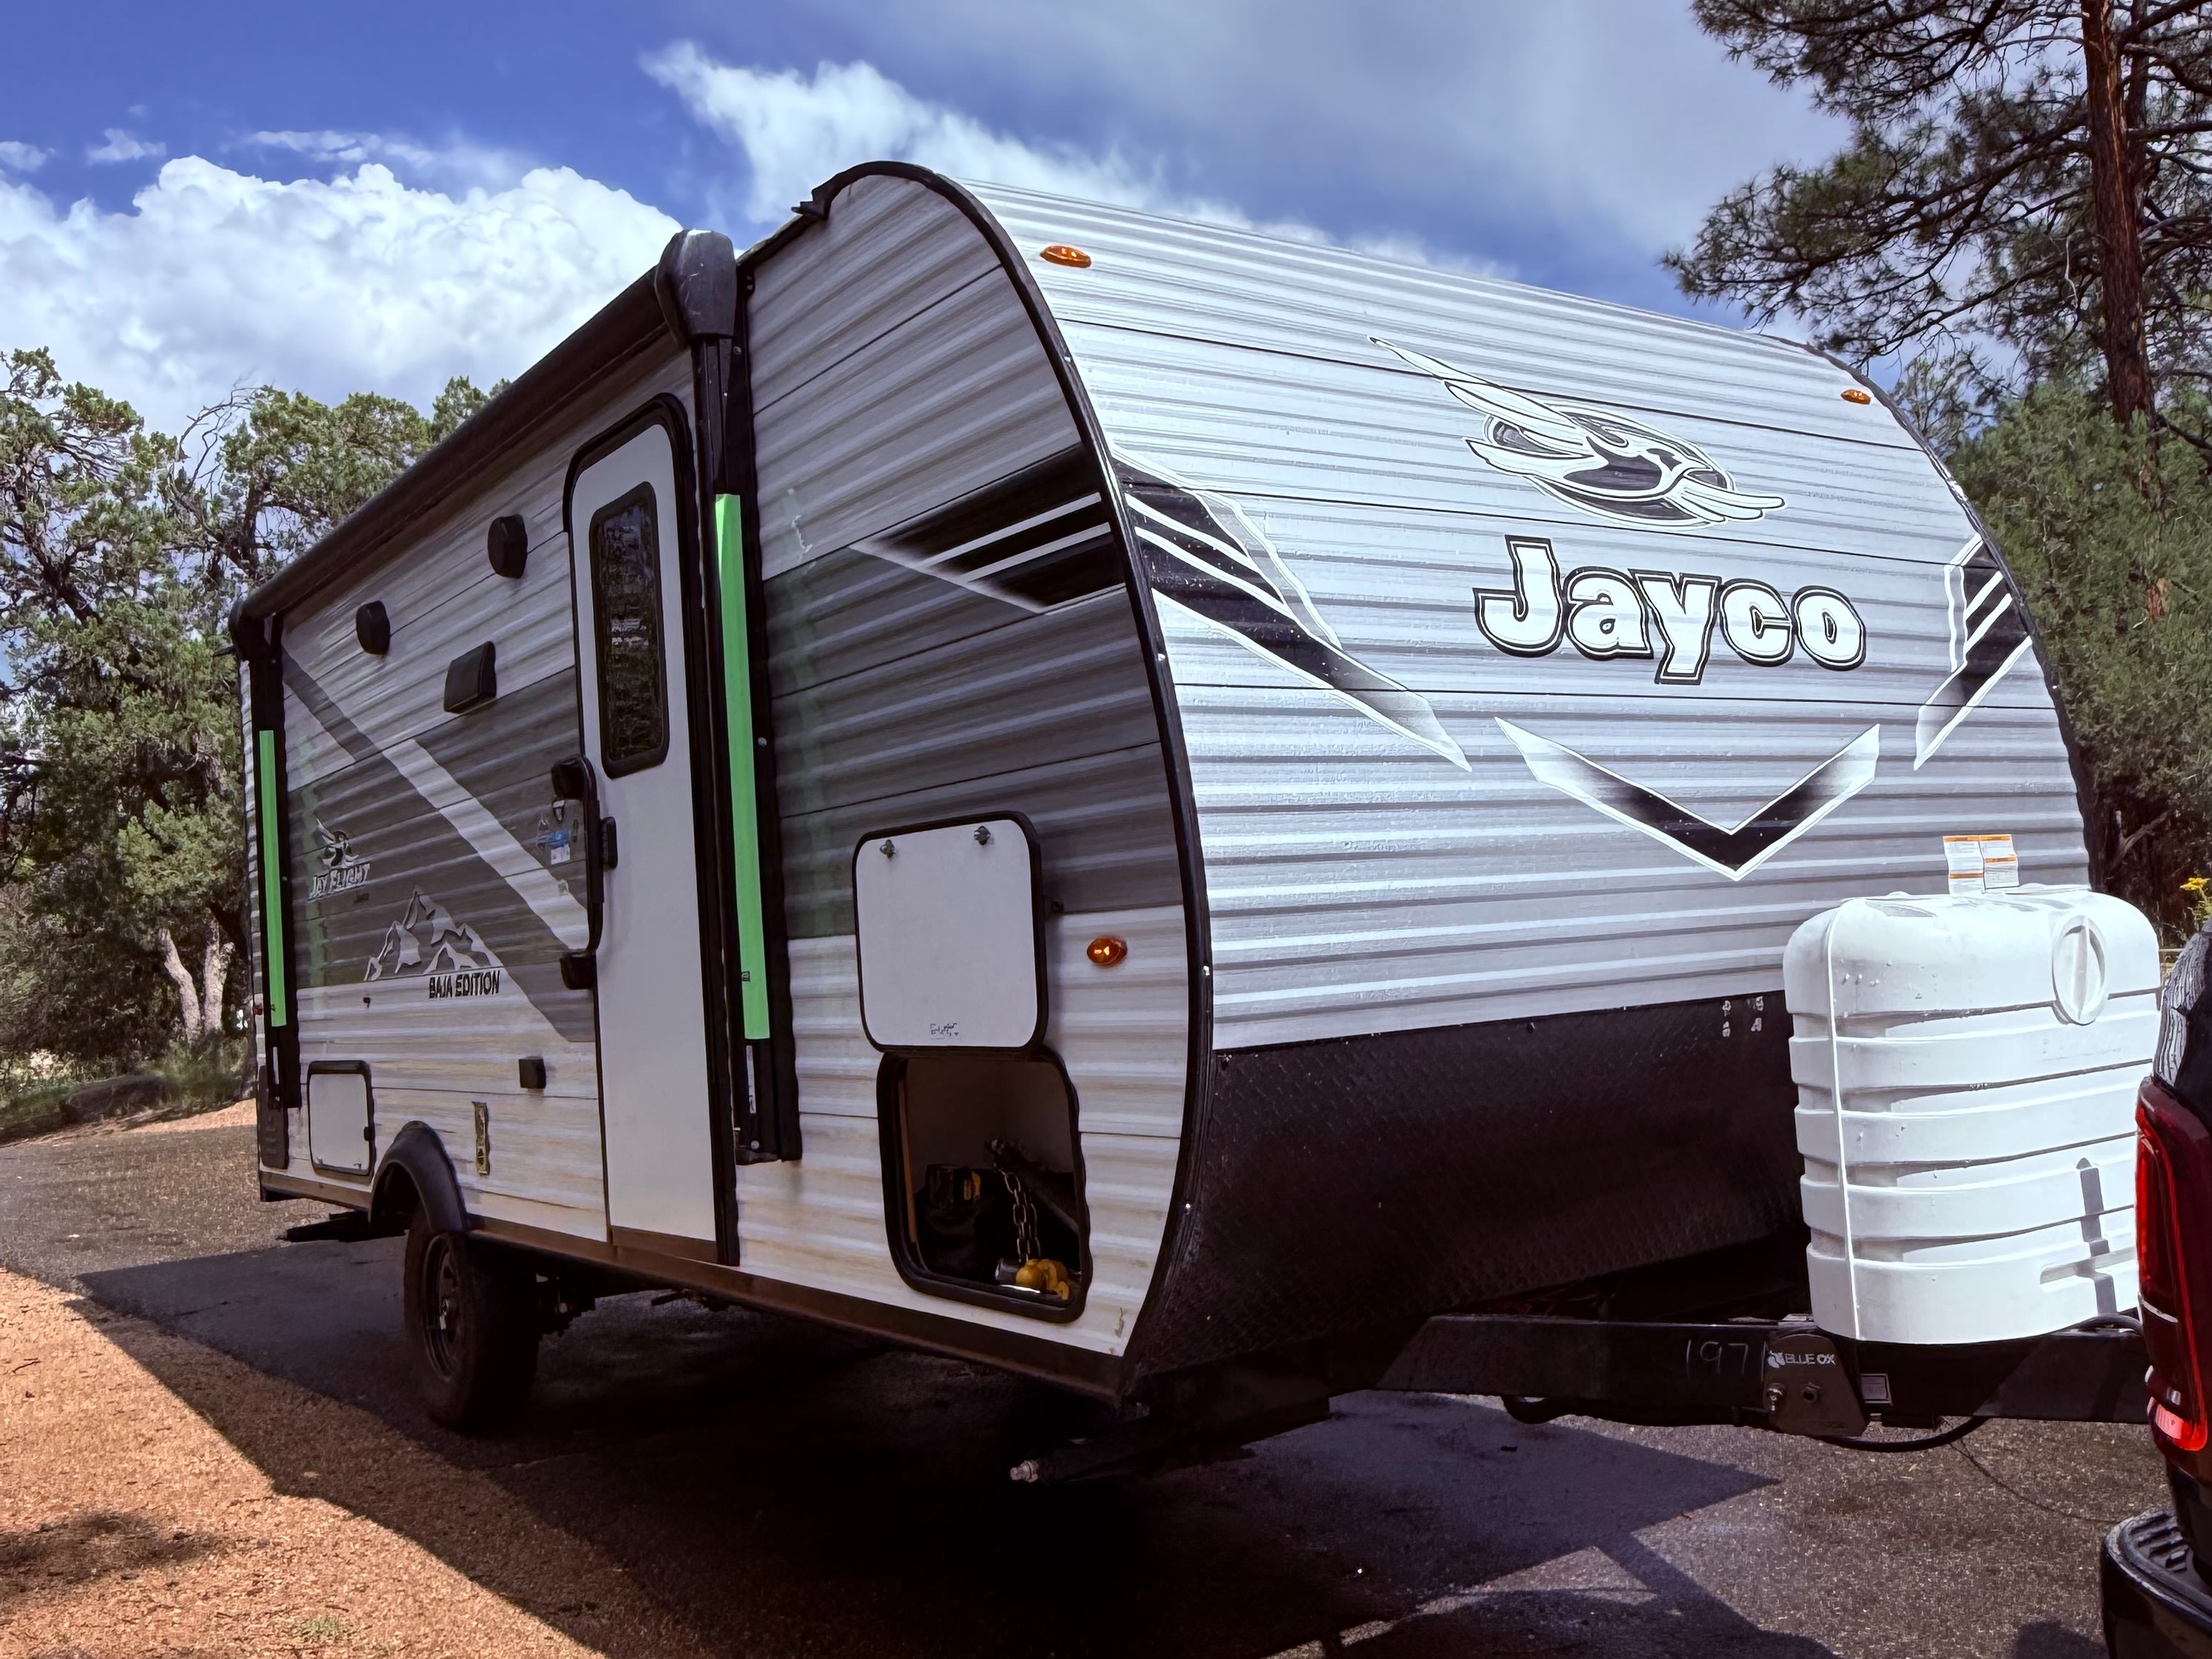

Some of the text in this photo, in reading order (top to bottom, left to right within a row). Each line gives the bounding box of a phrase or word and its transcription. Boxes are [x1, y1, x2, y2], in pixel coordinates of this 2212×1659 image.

[1472, 534, 1867, 685] Jayco
[429, 970, 500, 998] BAJA EDITION
[1816, 1353, 1836, 1366] OX
